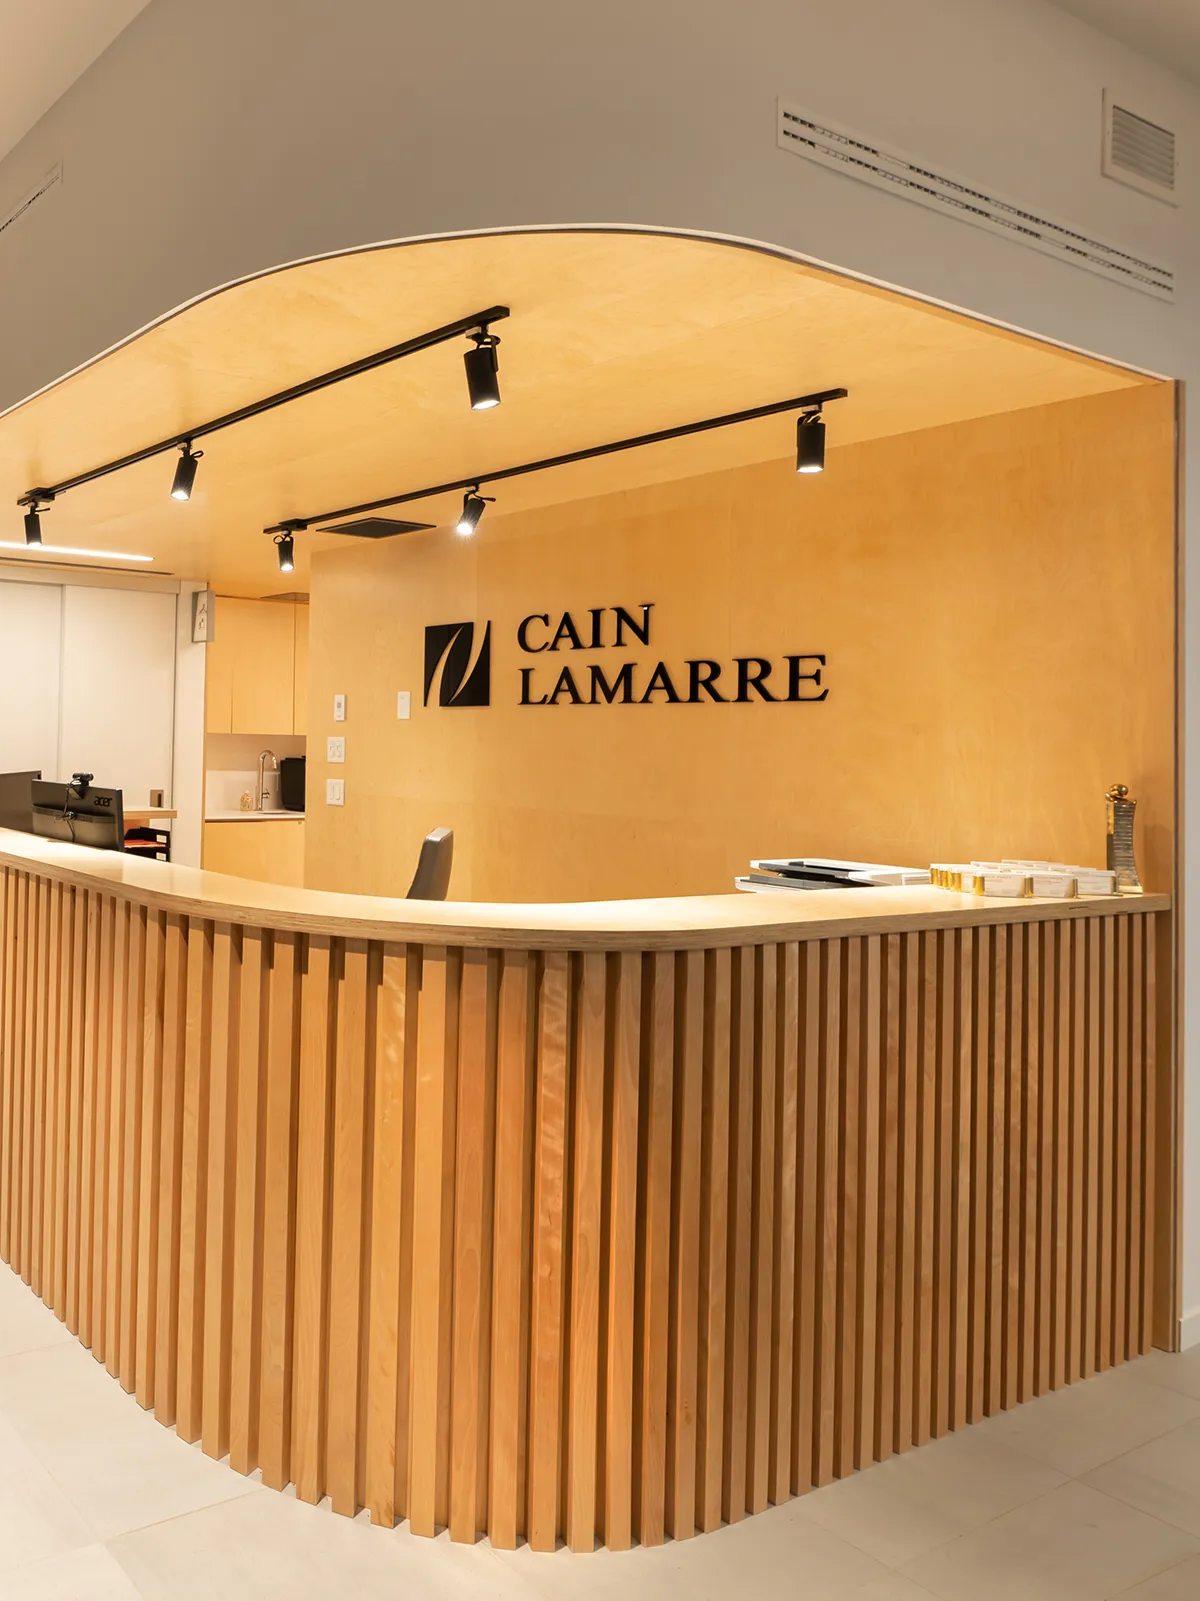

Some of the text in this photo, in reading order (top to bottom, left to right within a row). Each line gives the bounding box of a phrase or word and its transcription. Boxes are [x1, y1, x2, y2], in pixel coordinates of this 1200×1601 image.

[517, 603, 655, 653] CAIN
[517, 654, 830, 705] LAMARRE
[93, 796, 113, 807] acer
